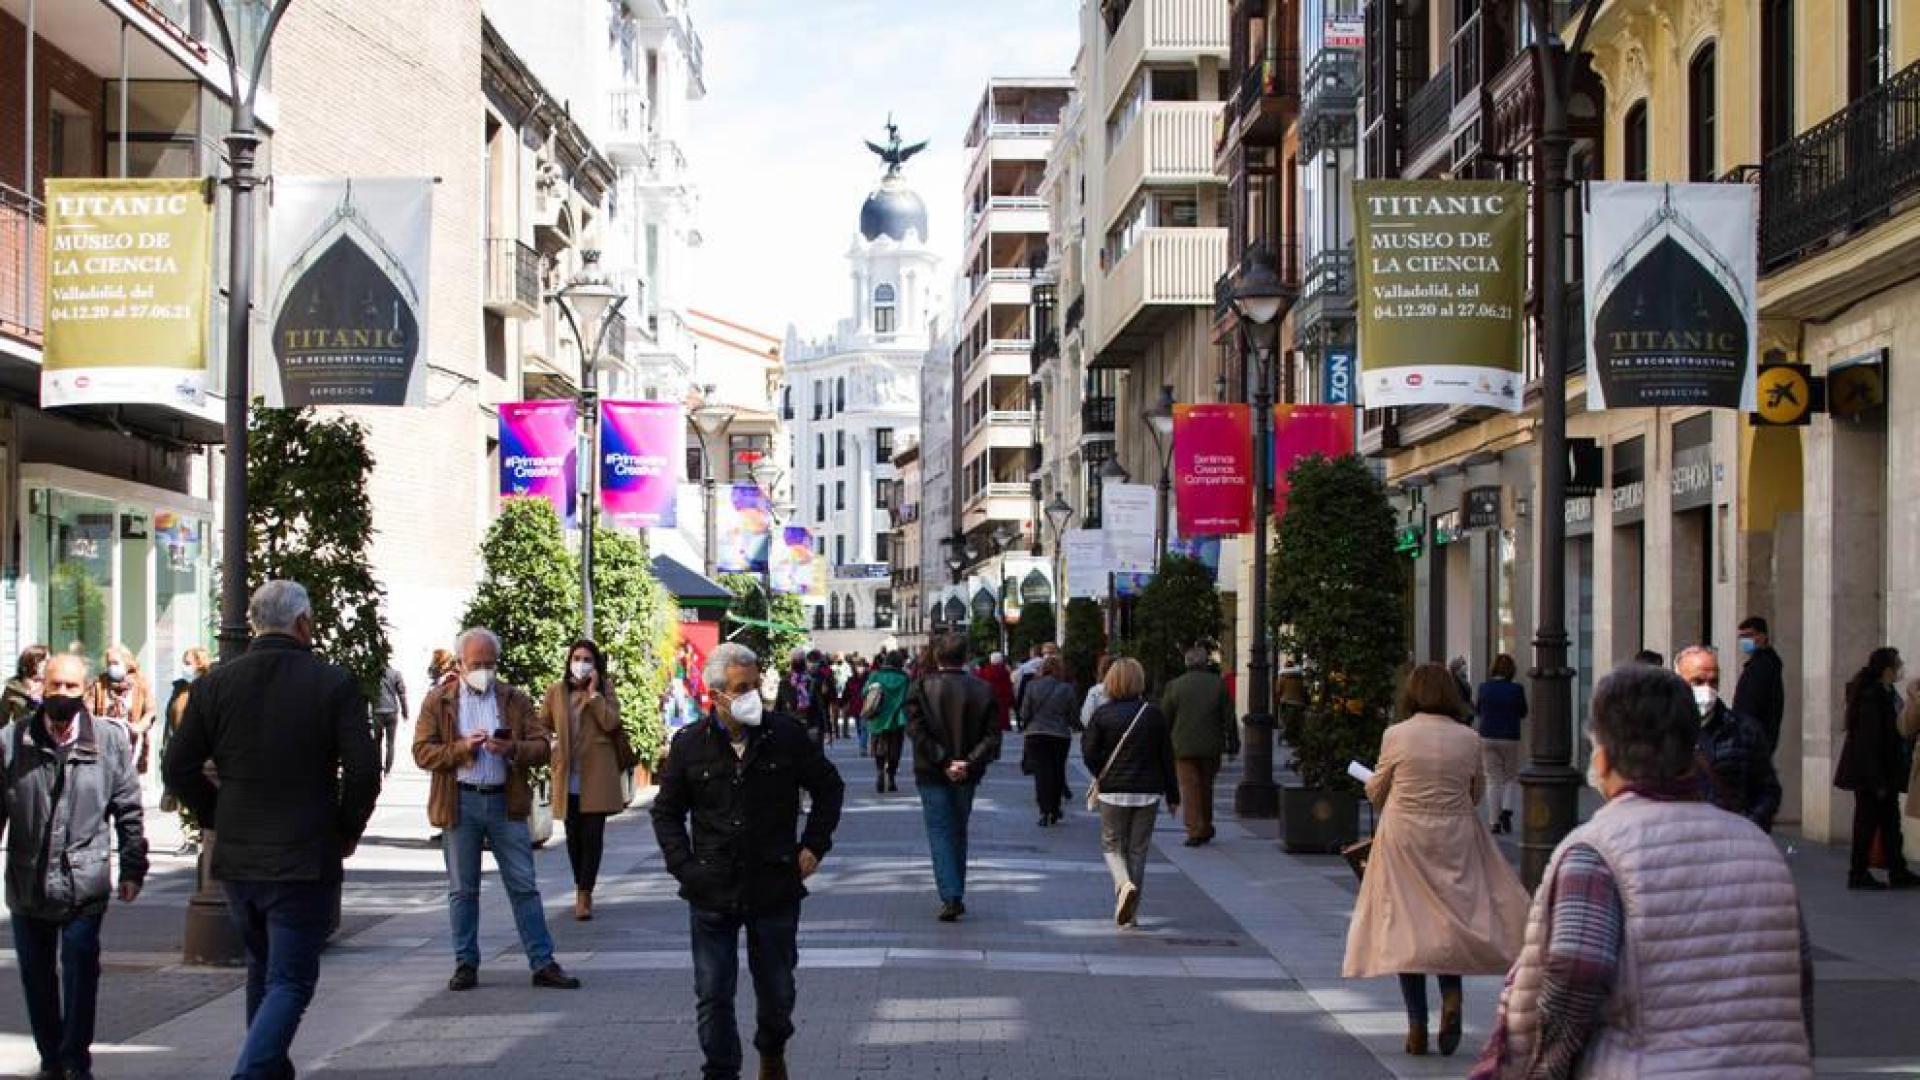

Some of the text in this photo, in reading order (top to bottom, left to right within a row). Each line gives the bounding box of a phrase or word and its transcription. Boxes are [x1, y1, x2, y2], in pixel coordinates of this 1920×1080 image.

[57, 194, 187, 216] TITANIC
[1369, 195, 1504, 216] TITANIC
[54, 232, 170, 250] MUSEO DE
[1371, 232, 1492, 249] MUSEO DE
[54, 257, 177, 275] LA CIENCIA
[1373, 256, 1500, 274] LA CIENCIA
[129, 284, 154, 298] del
[1457, 283, 1479, 297] del
[1374, 304, 1436, 319] 04.12.20
[1440, 304, 1454, 317] al
[285, 328, 404, 348] TITANIC
[1610, 330, 1737, 350] TITANIC
[1610, 356, 1736, 367] THE RECONSTRUCTION
[1331, 354, 1349, 405] ZON
